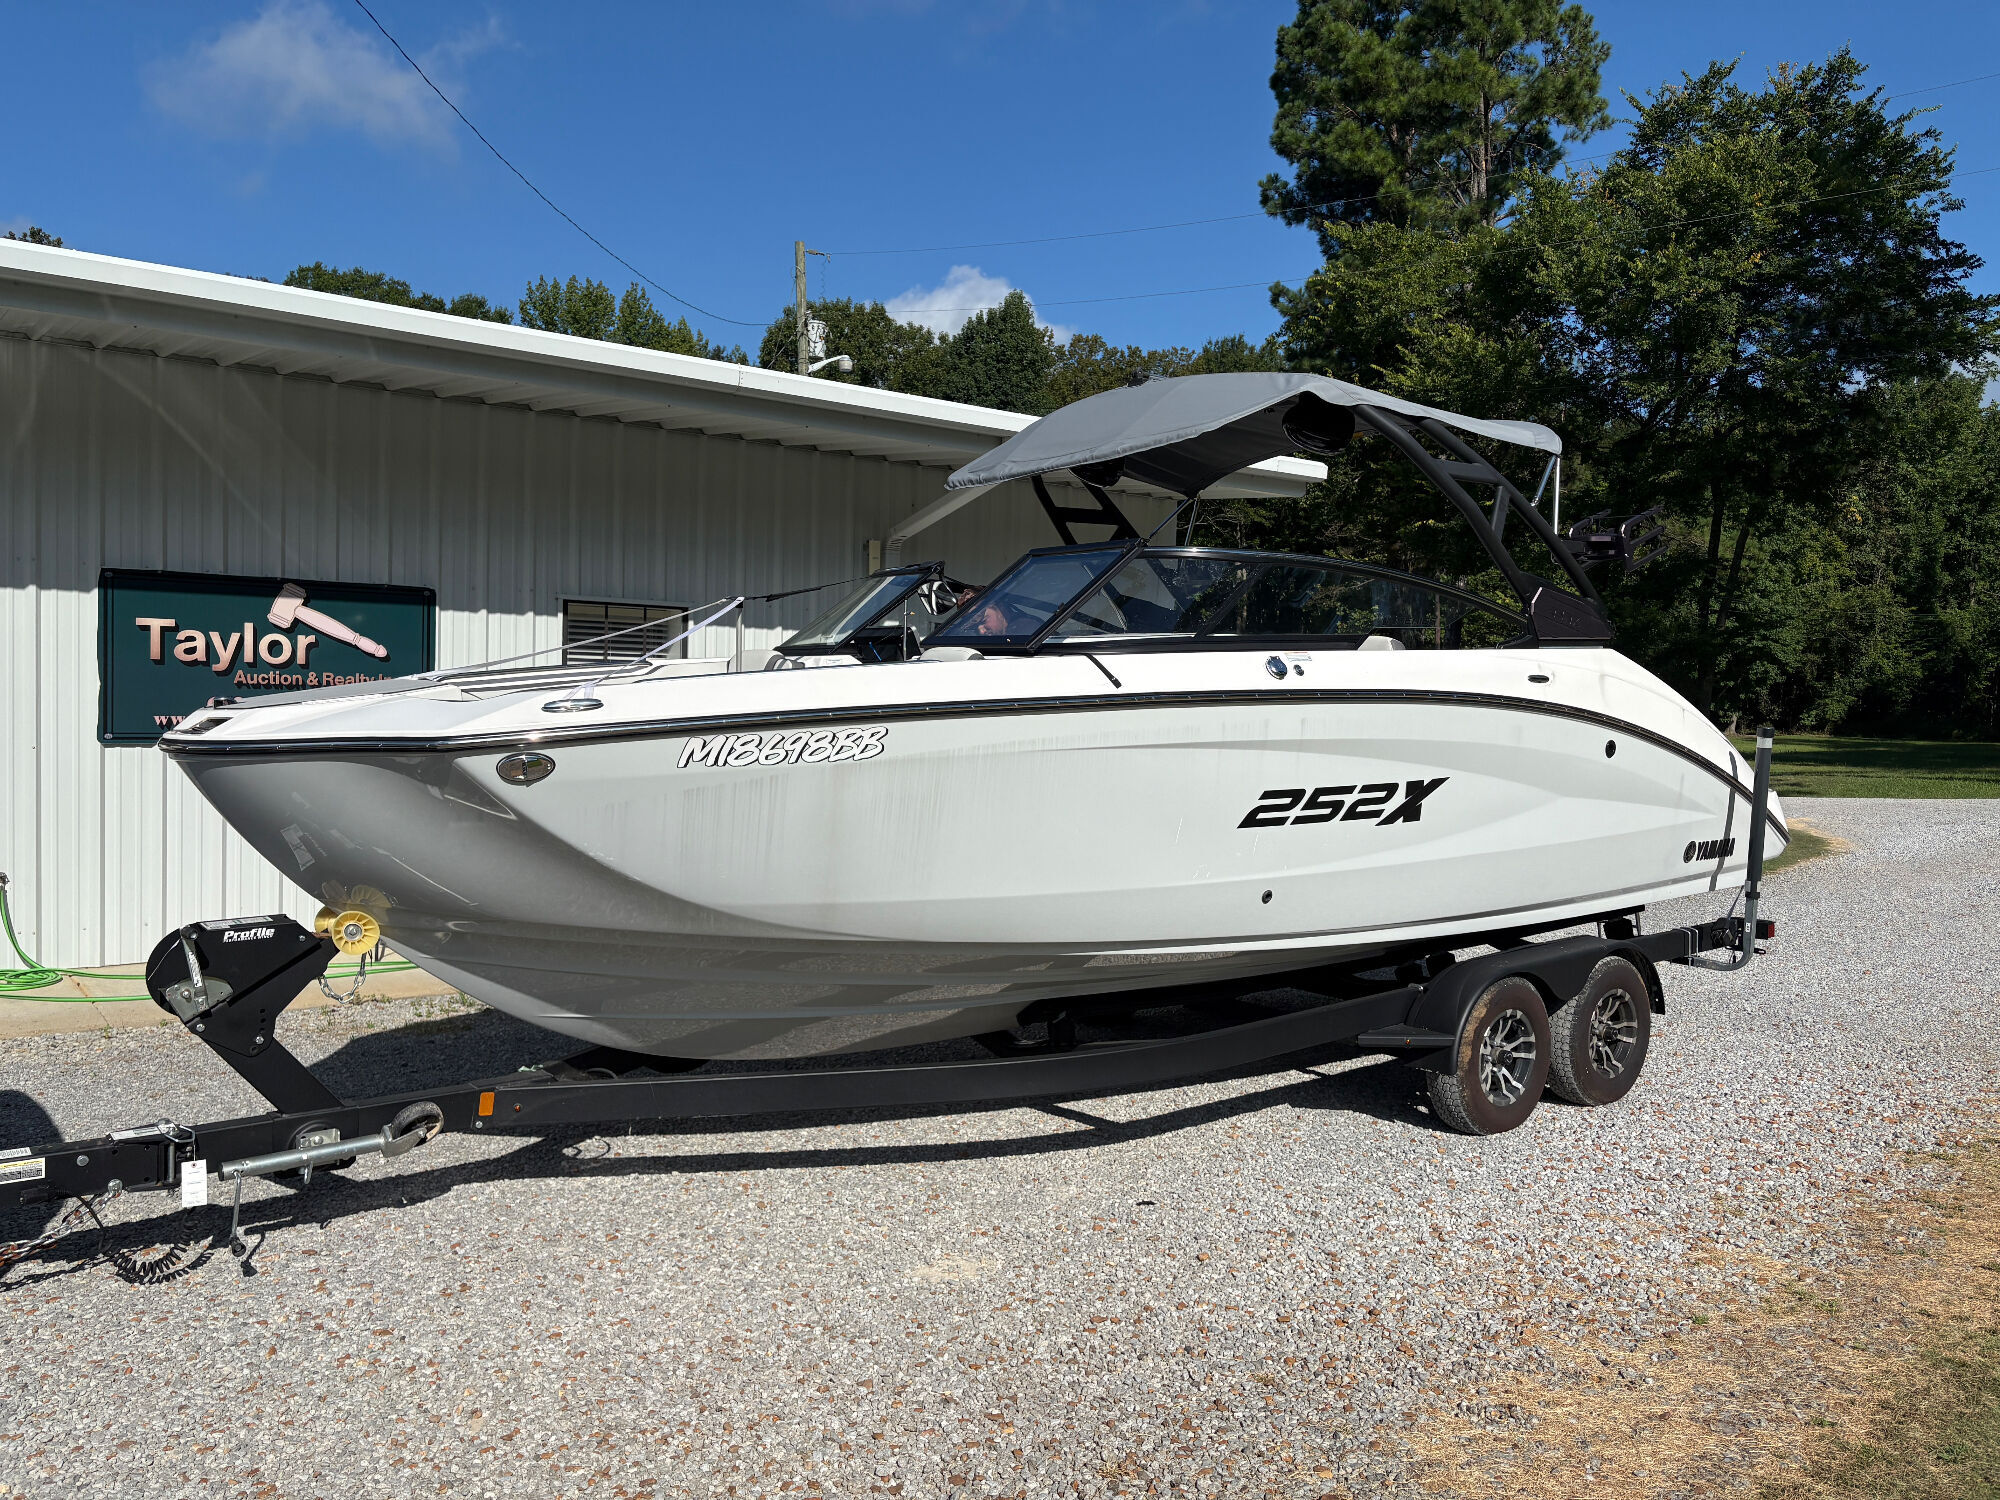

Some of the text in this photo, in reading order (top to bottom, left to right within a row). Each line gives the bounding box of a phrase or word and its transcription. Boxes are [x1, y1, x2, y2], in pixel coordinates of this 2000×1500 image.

[135, 617, 316, 672] Taylor
[233, 669, 303, 686] Auction
[306, 671, 319, 686] &
[676, 725, 889, 769] MI8698BB
[1236, 776, 1451, 829] 252X
[223, 927, 276, 941] Profile
